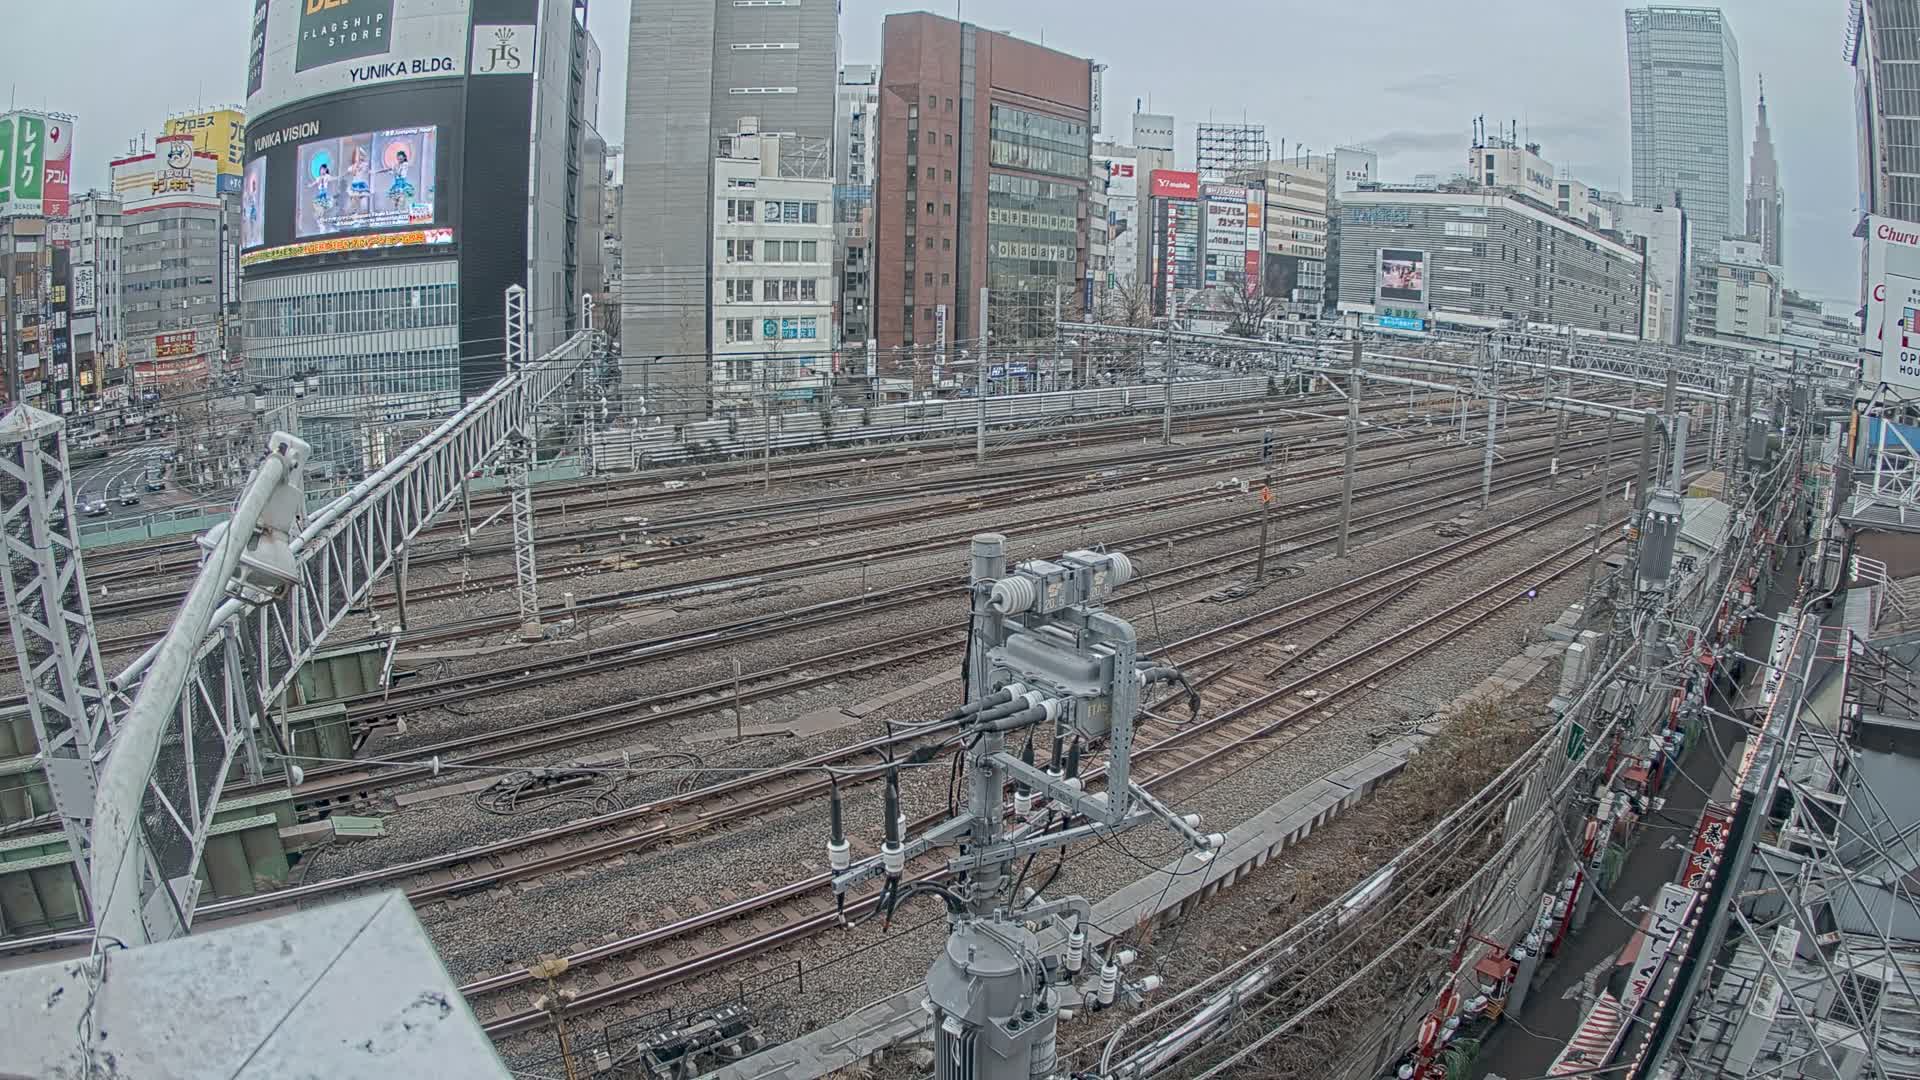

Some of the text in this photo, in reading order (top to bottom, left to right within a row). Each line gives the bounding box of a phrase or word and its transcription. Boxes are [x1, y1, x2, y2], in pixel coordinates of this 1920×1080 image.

[303, 13, 383, 41] FLAGSHIP
[328, 27, 382, 47] STORE
[350, 57, 456, 82] YUNIKA BLDG.
[175, 115, 215, 133] プロミス
[1134, 127, 1174, 136] TAKANO
[254, 120, 320, 152] YUNIKA VISION
[21, 121, 37, 188] レイク
[46, 168, 69, 185] アコム
[1209, 205, 1245, 216] ヨドバシ
[1217, 217, 1245, 228] カメラ
[1877, 224, 1919, 246] Churu
[1000, 244, 1065, 261] okadaya
